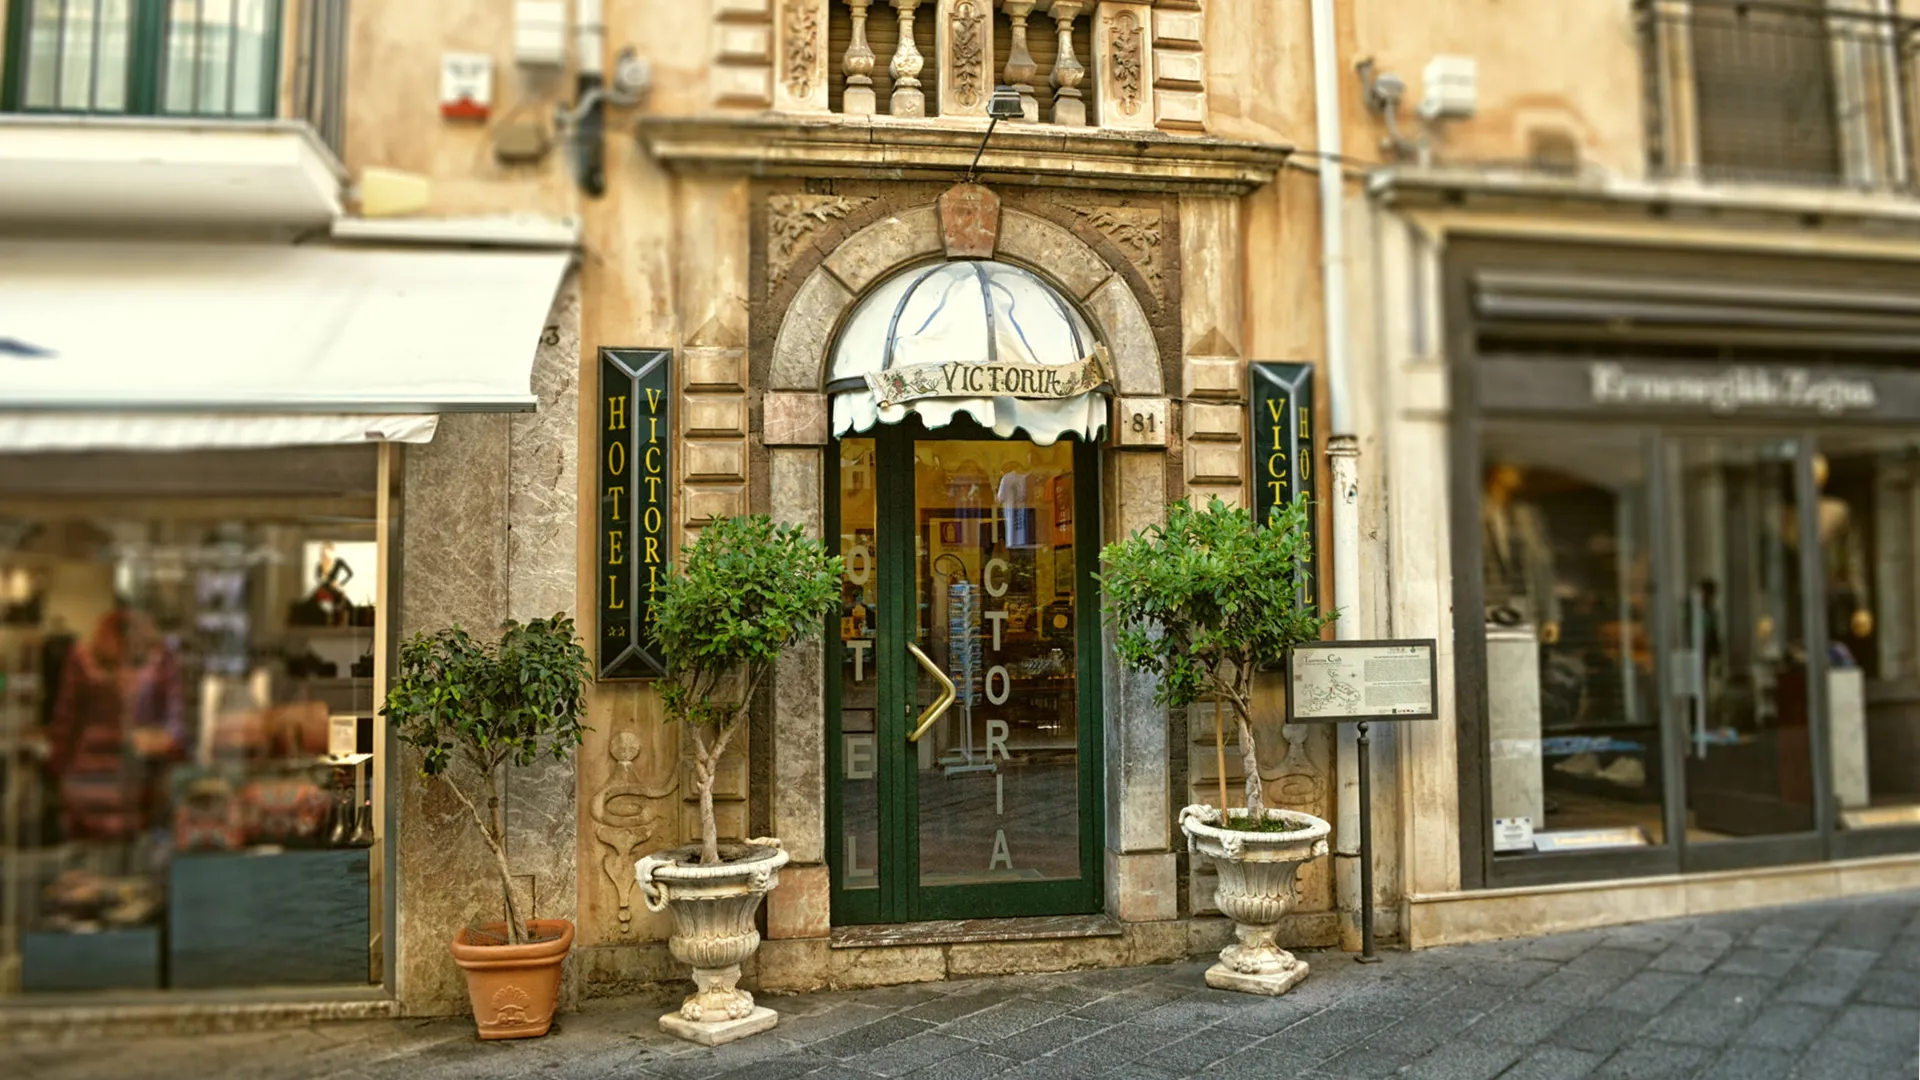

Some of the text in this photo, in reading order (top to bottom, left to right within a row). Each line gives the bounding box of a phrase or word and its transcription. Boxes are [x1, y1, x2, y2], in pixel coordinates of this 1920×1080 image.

[539, 325, 560, 346] 3
[940, 360, 1066, 396] VICTORIA
[1131, 412, 1156, 434] 81
[608, 396, 625, 610] HOTEL
[643, 388, 661, 622] VICTORIA
[846, 449, 874, 878] HOTEL
